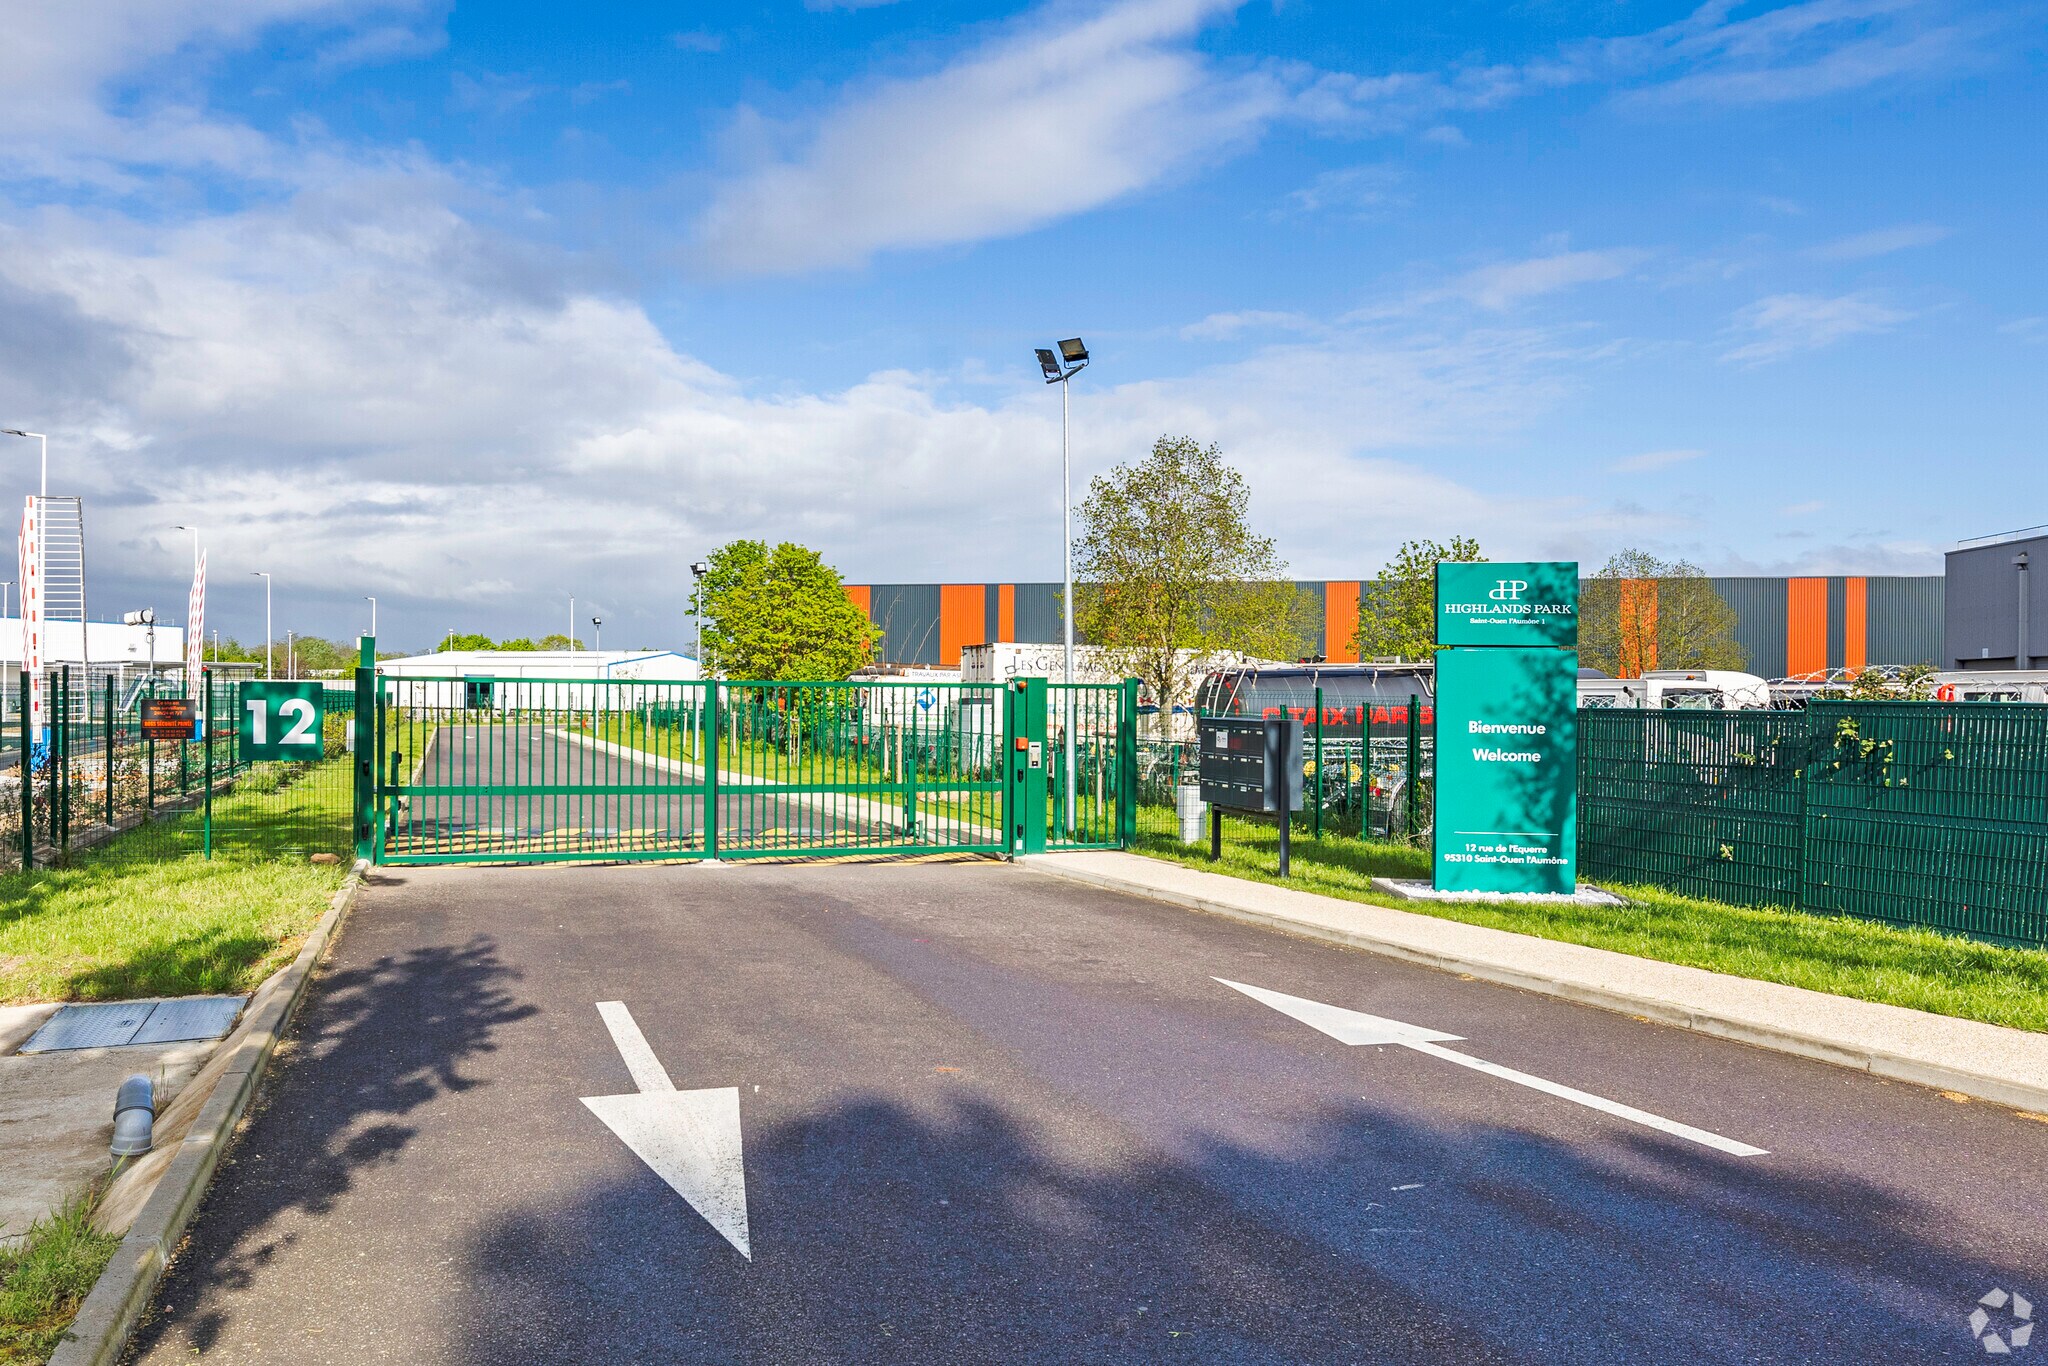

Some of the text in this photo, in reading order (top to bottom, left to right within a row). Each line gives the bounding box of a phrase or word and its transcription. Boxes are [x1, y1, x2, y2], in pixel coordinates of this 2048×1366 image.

[1444, 603, 1572, 614] HIGHLANDS PARK
[246, 698, 317, 745] 12
[1355, 706, 1434, 725] PARS
[1468, 720, 1546, 735] Bienvenue
[1472, 748, 1542, 762] Welcome
[1465, 843, 1476, 852] 12
[1495, 844, 1507, 853] de
[1443, 853, 1569, 865] 95310 Saint-Ouen l'Aumône
